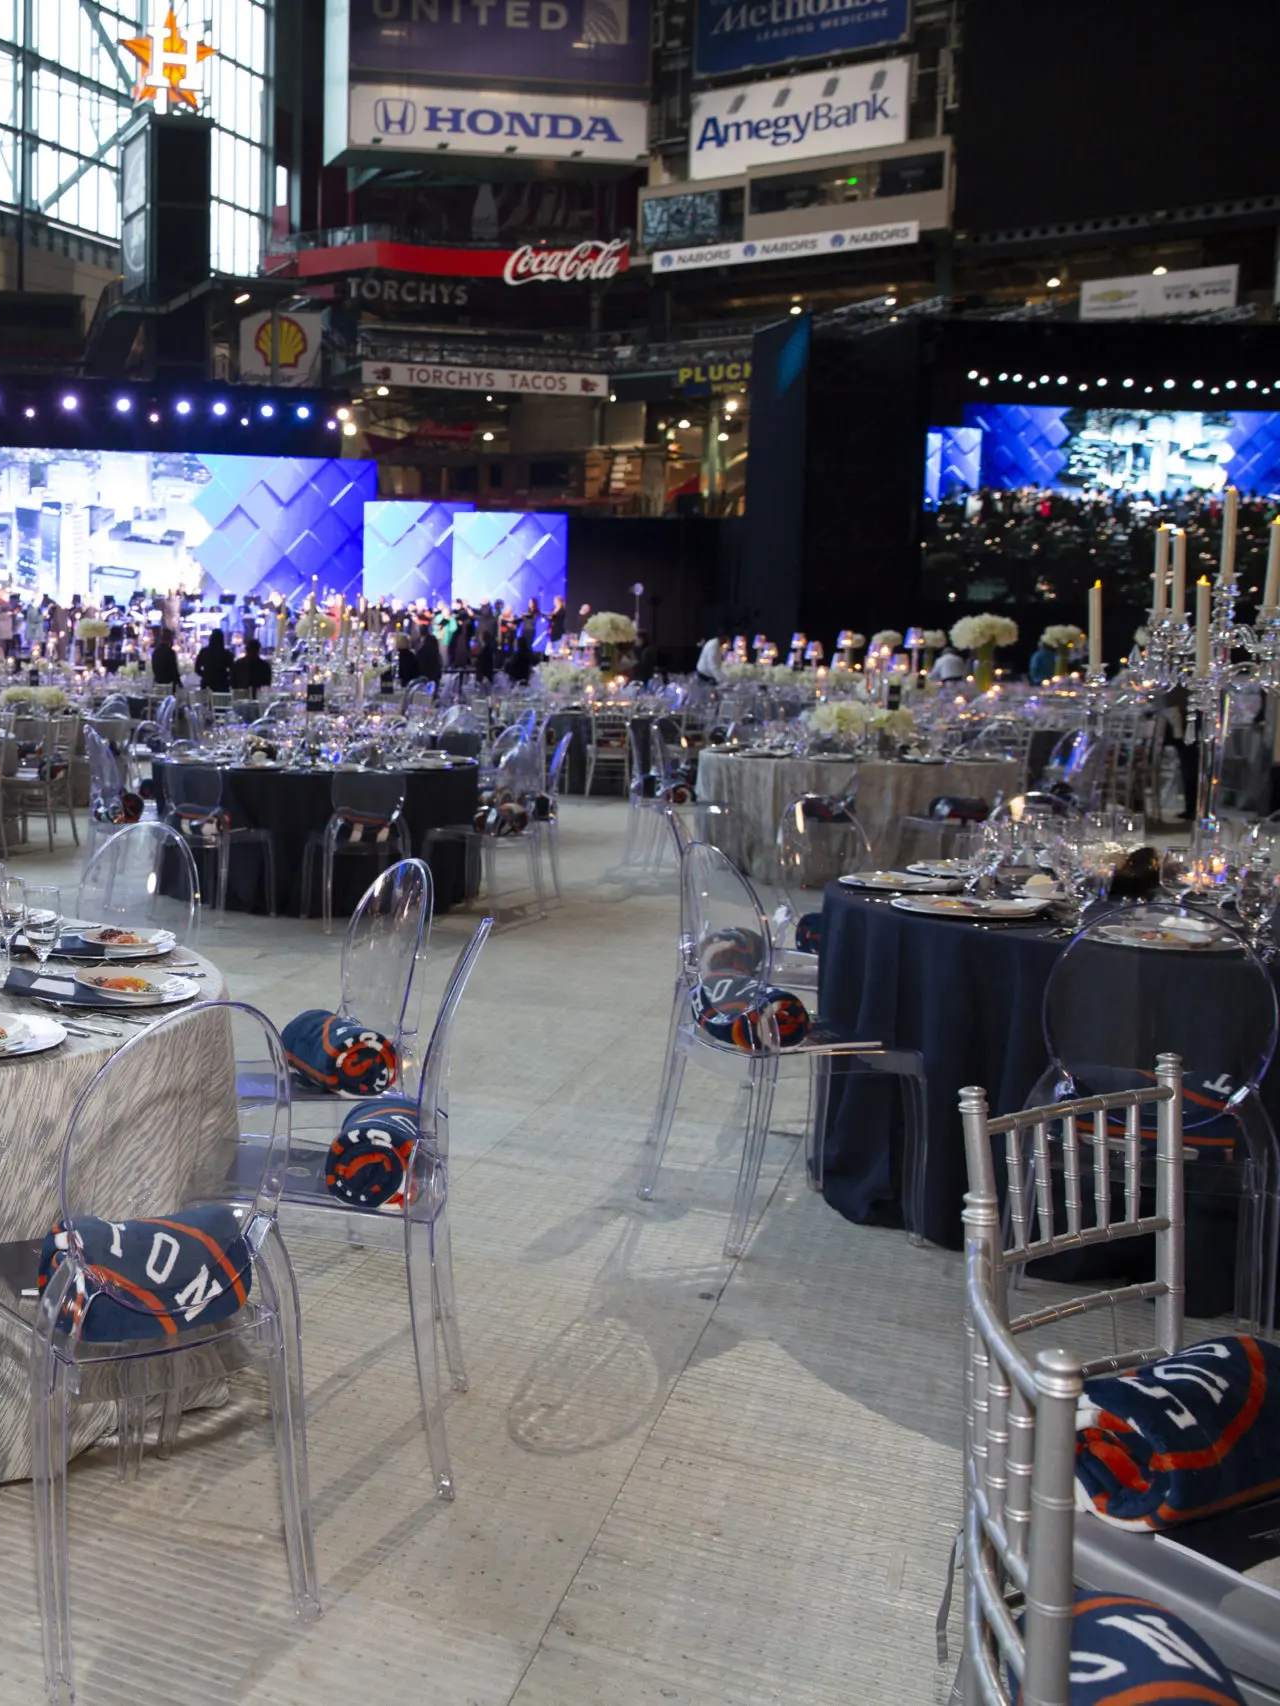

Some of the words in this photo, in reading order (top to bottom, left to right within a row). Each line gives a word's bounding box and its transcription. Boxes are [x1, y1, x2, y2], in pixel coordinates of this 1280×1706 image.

[372, 0, 569, 30] UNITED
[755, 23, 815, 42] LEADING
[821, 7, 889, 30] MEDICINE
[423, 105, 623, 143] HONDA
[696, 92, 890, 151] AmegyBank
[676, 248, 732, 265] NABORS
[760, 238, 818, 255] NABORS
[849, 226, 910, 245] NABORS
[346, 276, 469, 306] TORCHYS
[406, 366, 495, 388] TORCHYS
[509, 372, 568, 392] TACOS
